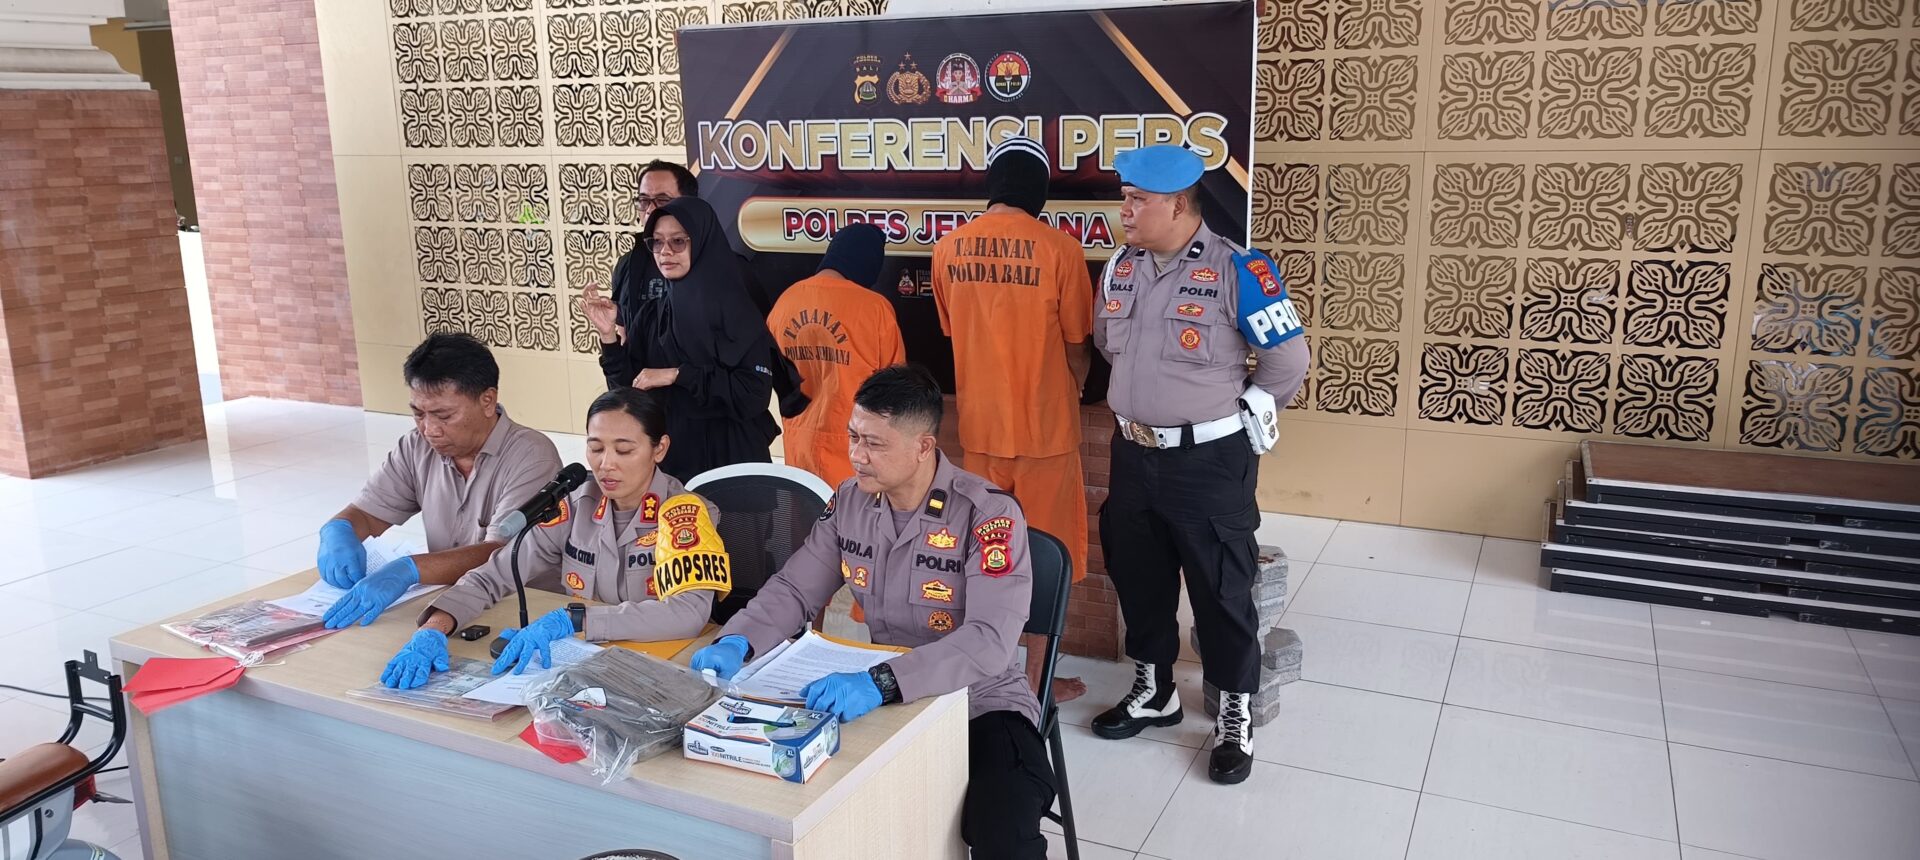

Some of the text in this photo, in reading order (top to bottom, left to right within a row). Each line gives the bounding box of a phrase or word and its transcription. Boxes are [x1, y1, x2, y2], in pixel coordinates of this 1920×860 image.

[912, 211, 1117, 249] JENA
[954, 237, 1036, 260] TAHANAN
[947, 262, 998, 283] POLDA
[1001, 264, 1041, 287] BALI
[1179, 286, 1218, 298] POLRI
[783, 308, 848, 345] TAHANAN
[784, 346, 814, 361] POLRES
[839, 535, 873, 560] UDI.A
[984, 532, 1007, 541] BALI
[656, 553, 728, 597] KAOPSRES
[916, 553, 961, 573] POLRI
